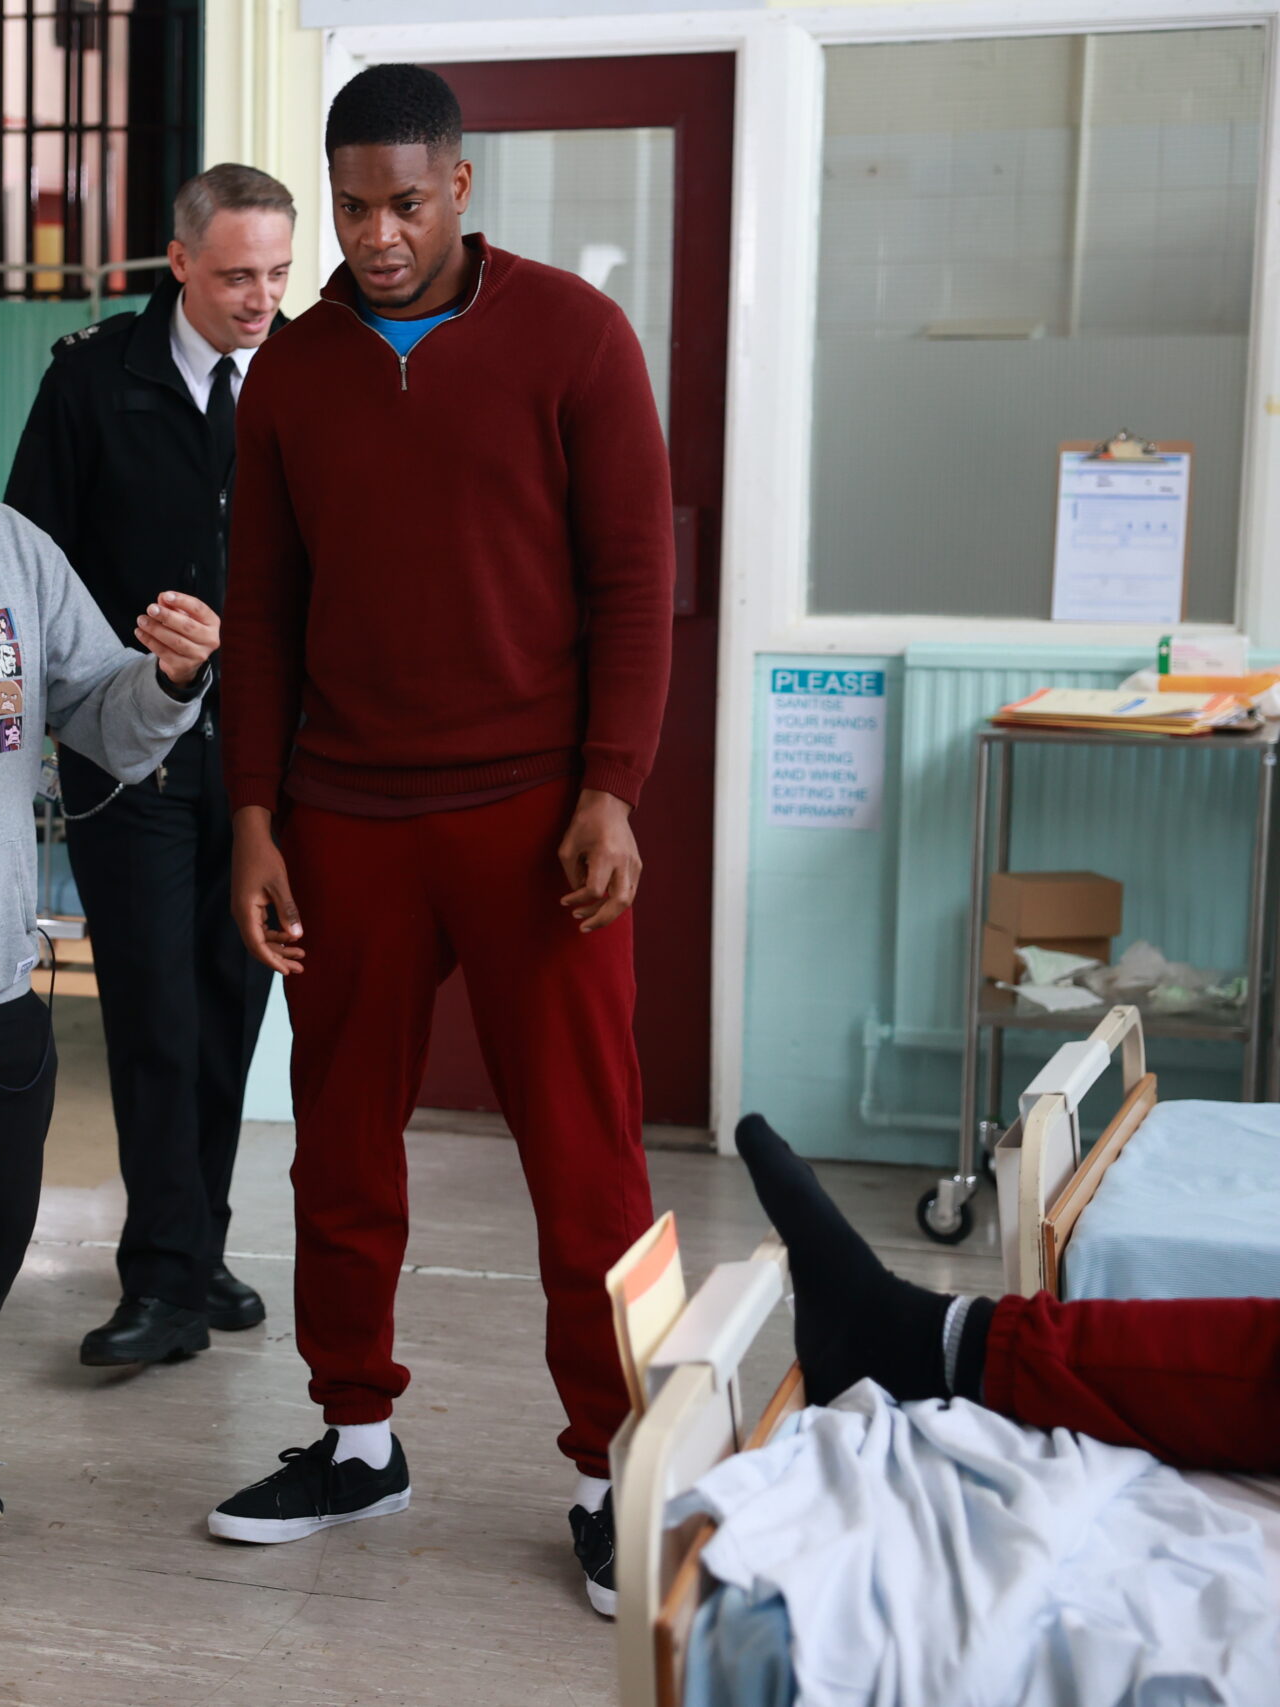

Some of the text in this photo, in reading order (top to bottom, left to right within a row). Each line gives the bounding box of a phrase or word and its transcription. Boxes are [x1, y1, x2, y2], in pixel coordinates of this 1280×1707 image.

[775, 671, 877, 693] PLEASE
[775, 697, 844, 711] SANITISE
[776, 715, 878, 731] YOUR HANDS
[774, 732, 836, 746] BEFORE
[773, 750, 854, 764] ENTERING
[773, 768, 858, 782] AND WHEN
[773, 786, 868, 802] EXITING THE
[773, 804, 857, 818] INFIRMARY
